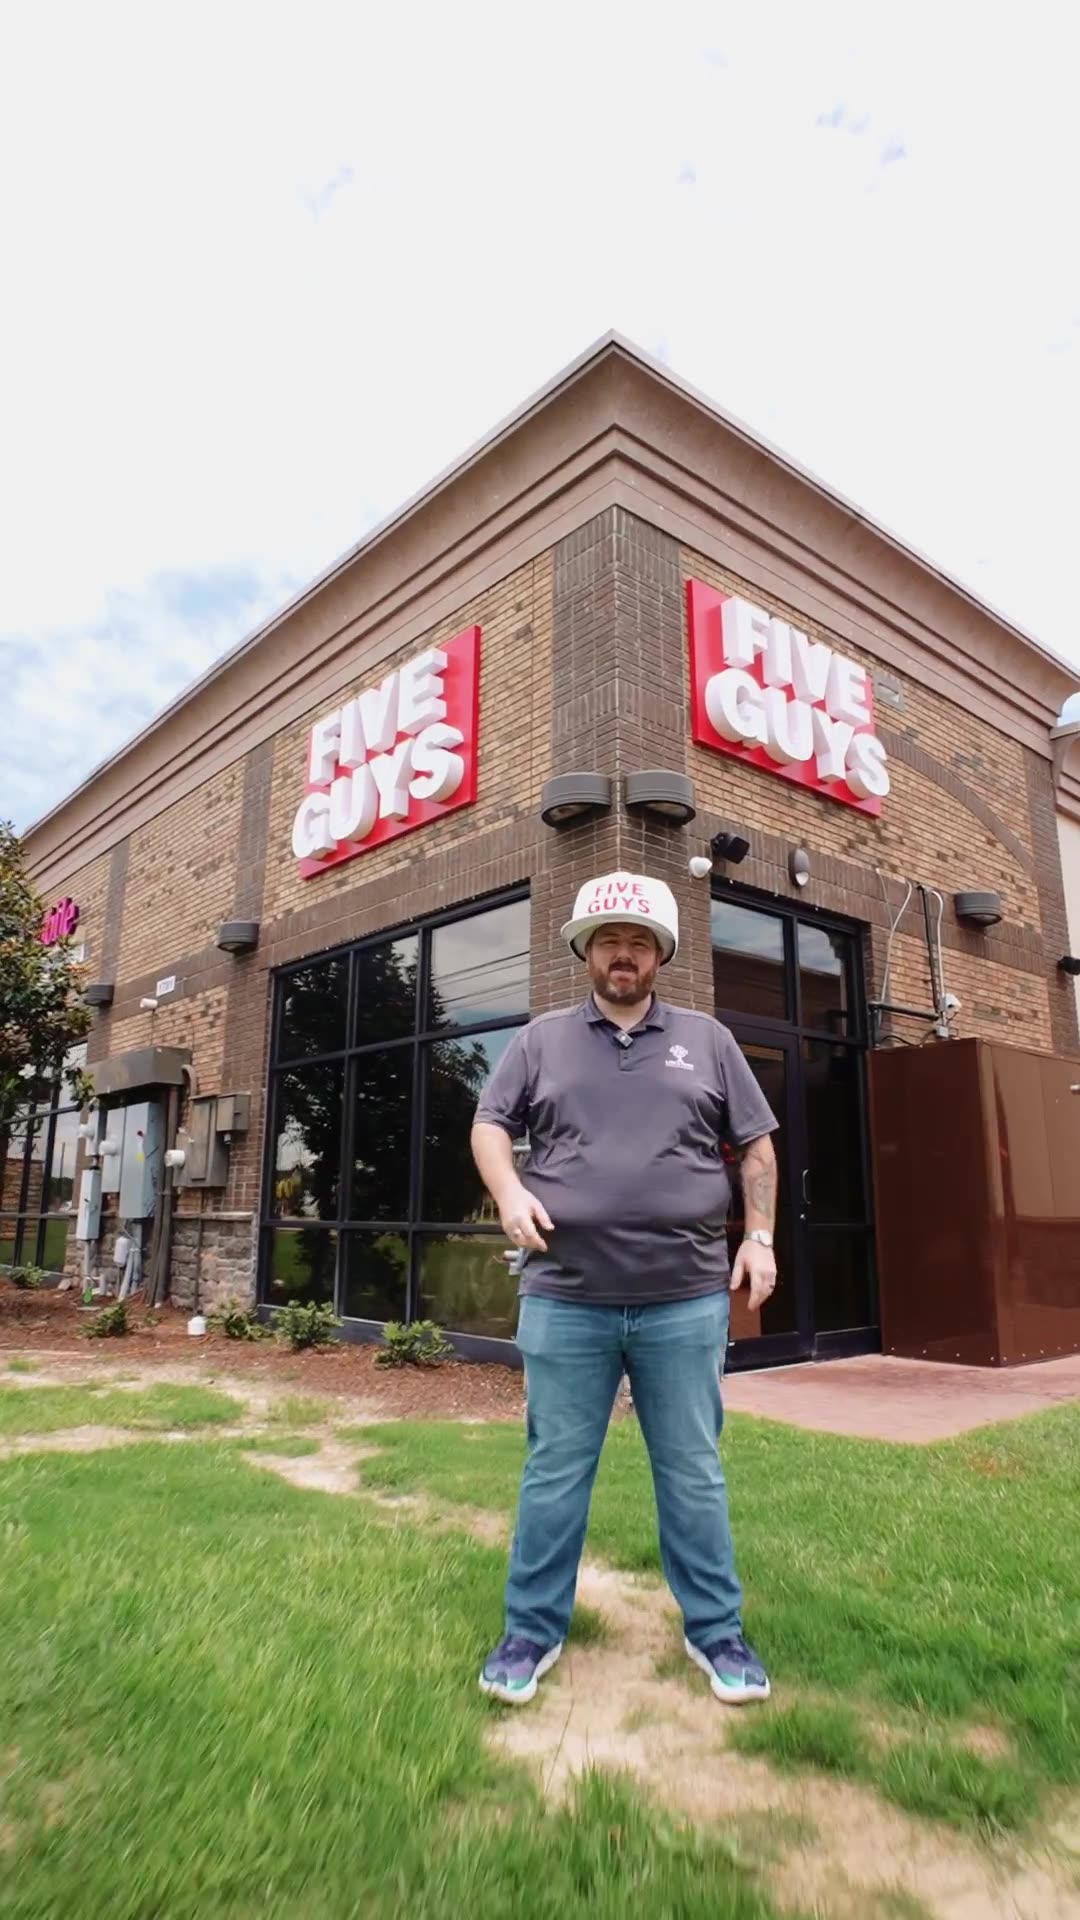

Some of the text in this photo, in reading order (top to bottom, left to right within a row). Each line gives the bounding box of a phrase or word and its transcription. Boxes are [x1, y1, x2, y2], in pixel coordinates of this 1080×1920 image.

[308, 647, 448, 787] FIVE
[720, 596, 871, 727] FIVE
[292, 722, 465, 861] GUYS
[705, 667, 891, 799] GUYS
[587, 897, 651, 914] GUYS
[595, 881, 645, 897] FIVE
